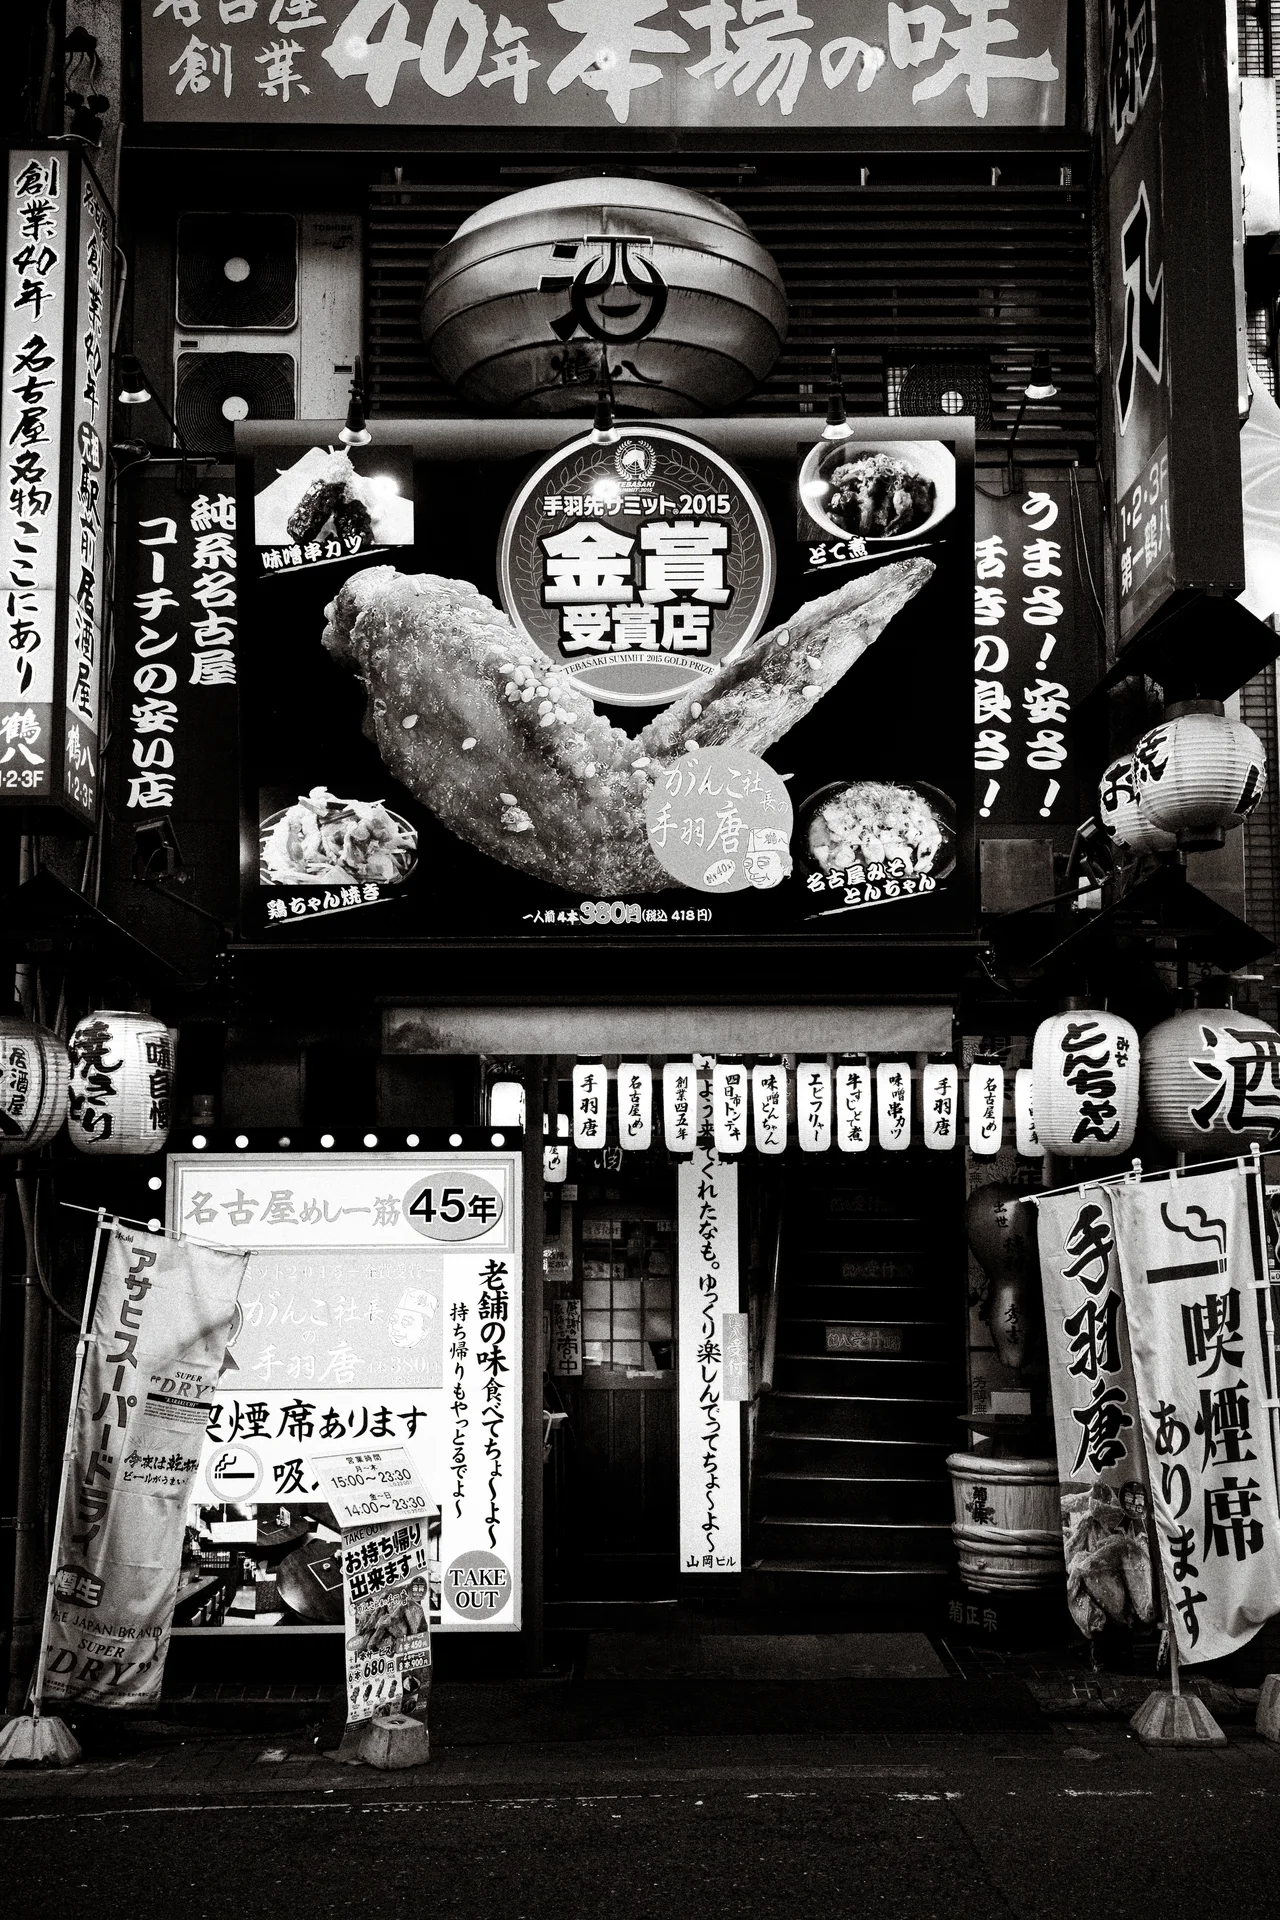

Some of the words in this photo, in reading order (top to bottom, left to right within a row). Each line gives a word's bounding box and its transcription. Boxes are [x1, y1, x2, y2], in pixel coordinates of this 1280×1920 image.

[260, 536, 363, 571] 味噌串カツ
[542, 521, 731, 603] 金賞
[808, 538, 868, 565] どて煮
[189, 493, 237, 686] 純系名古屋
[561, 603, 711, 651] 受賞店
[127, 517, 180, 808] コーチンの安い店
[564, 656, 608, 676] TEBASAKI
[609, 653, 645, 664] SUMMIT
[646, 654, 663, 664] 2015
[663, 656, 686, 669] GOLD
[688, 660, 715, 676] PRIZE
[0, 709, 46, 763] 鶴八
[66, 724, 95, 777] 鶴八
[650, 801, 749, 854] 手羽唐
[267, 883, 380, 919] 鶏ちゃん焼き
[806, 857, 905, 893] 名古屋みそ
[844, 873, 936, 903] とんちゃん
[580, 1073, 599, 1138] 手羽唐
[627, 1075, 644, 1137] 名古屋めし
[674, 1076, 690, 1141] 創業四五年
[724, 1073, 742, 1142] 四日市トンテキ
[808, 1073, 825, 1142] エビフリャー
[845, 1073, 864, 1143] 牛すじどて煮
[887, 1072, 906, 1140] 味噌串カツ
[933, 1077, 953, 1137] 手羽唐
[981, 1076, 998, 1140] 名古屋めし
[1061, 1021, 1121, 1144] とんちゃん
[761, 1073, 780, 1146] 味噌とんちゃん
[184, 1189, 401, 1228] 名古屋めし一筋
[243, 1290, 385, 1328] がんこ社長
[251, 1340, 365, 1384] 手羽唐
[301, 1330, 317, 1345] の
[1061, 1203, 1134, 1477] 手羽唐
[72, 1247, 158, 1556] アサヒスーパードライ
[175, 1371, 203, 1383] SUPER
[1181, 1287, 1264, 1562] 喫煙席
[346, 1454, 382, 1464] 営業時間
[972, 1486, 989, 1525] 菊正宗
[1150, 1400, 1207, 1648] あります
[344, 1530, 364, 1545] TAKE
[344, 1523, 421, 1576] お持ち帰り
[686, 1555, 737, 1569] 山岡ビル
[55, 1570, 102, 1606] 樽生
[450, 1570, 506, 1587] TAKE
[455, 1591, 500, 1609] OUT
[73, 1614, 114, 1635] JAPAN
[118, 1627, 163, 1639] BRAND
[78, 1638, 126, 1658] SUPER
